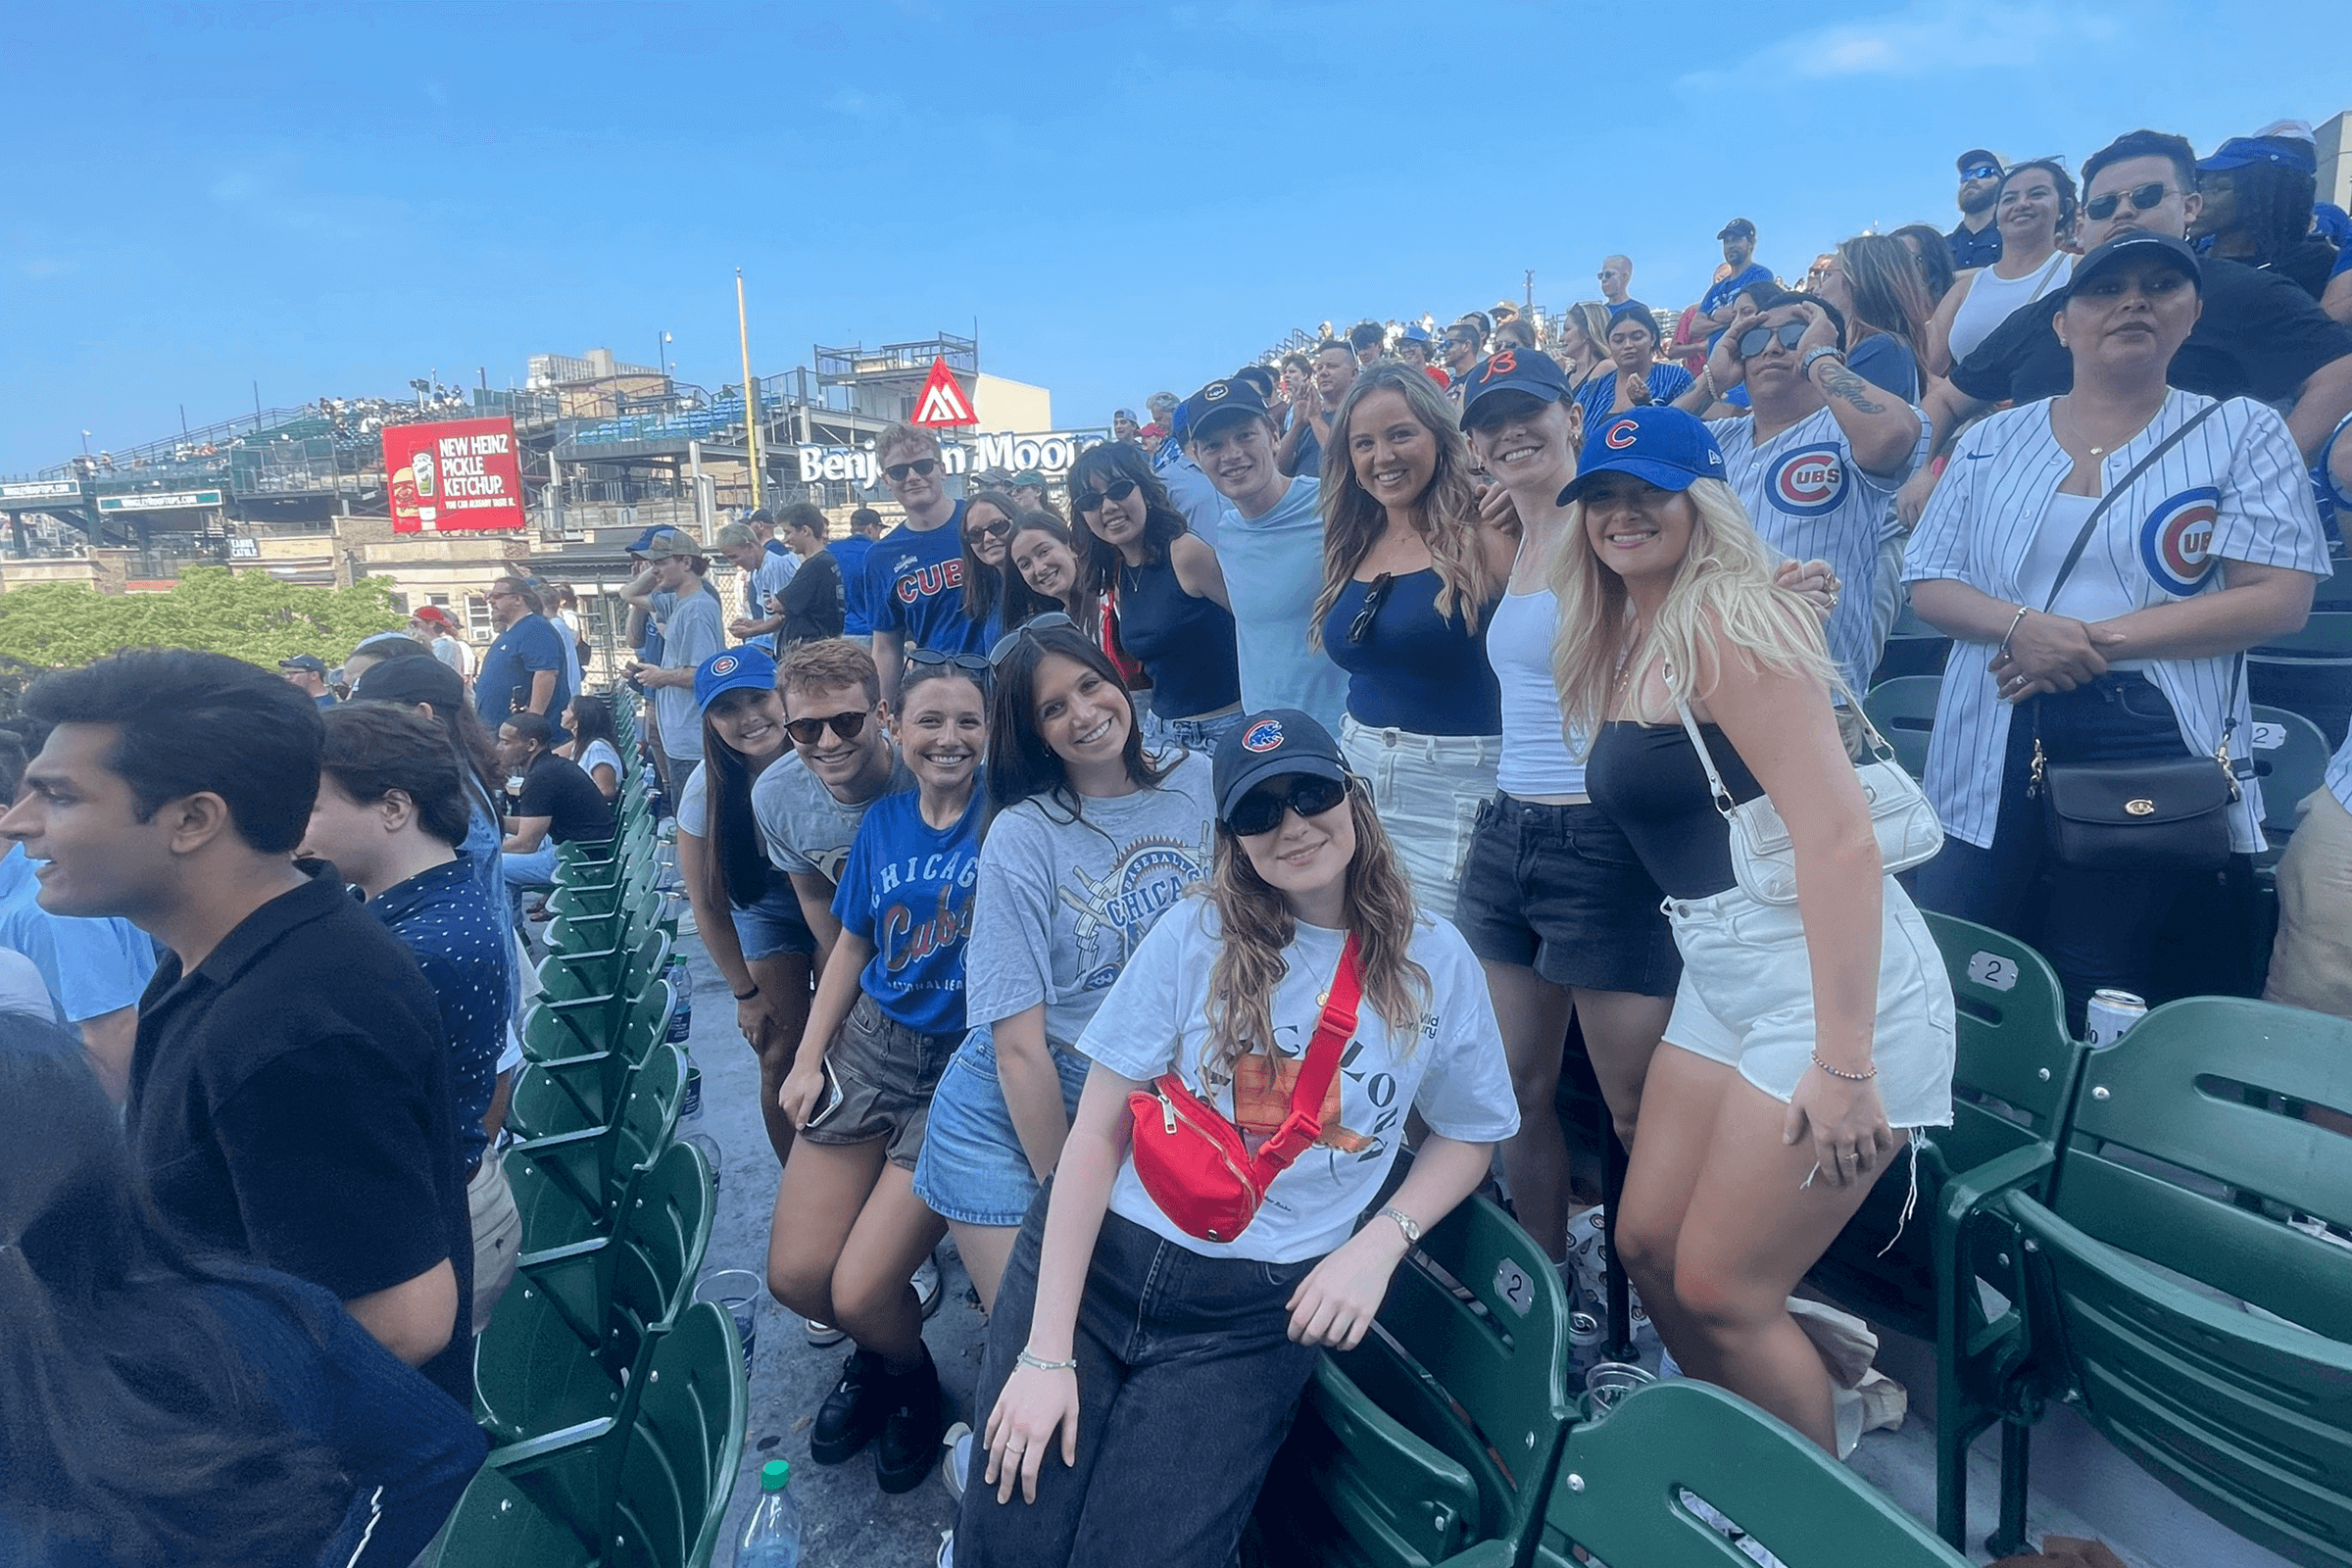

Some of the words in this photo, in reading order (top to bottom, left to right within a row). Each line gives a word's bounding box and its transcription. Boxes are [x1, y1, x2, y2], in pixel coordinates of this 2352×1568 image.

[438, 436, 469, 458] NEW
[470, 434, 510, 456] HEINZ
[1605, 418, 1640, 450] C
[441, 456, 485, 477] PICKLE
[799, 435, 967, 490] Benjn
[443, 474, 505, 497] KETCHUP.
[896, 557, 964, 605] CUB
[2252, 726, 2270, 744] 2
[871, 851, 979, 909] CHICAG
[1124, 853, 1187, 891] BASEBALL
[1105, 866, 1211, 928] CHICAG
[1984, 960, 2002, 983] 2
[1506, 1274, 1522, 1303] 2
